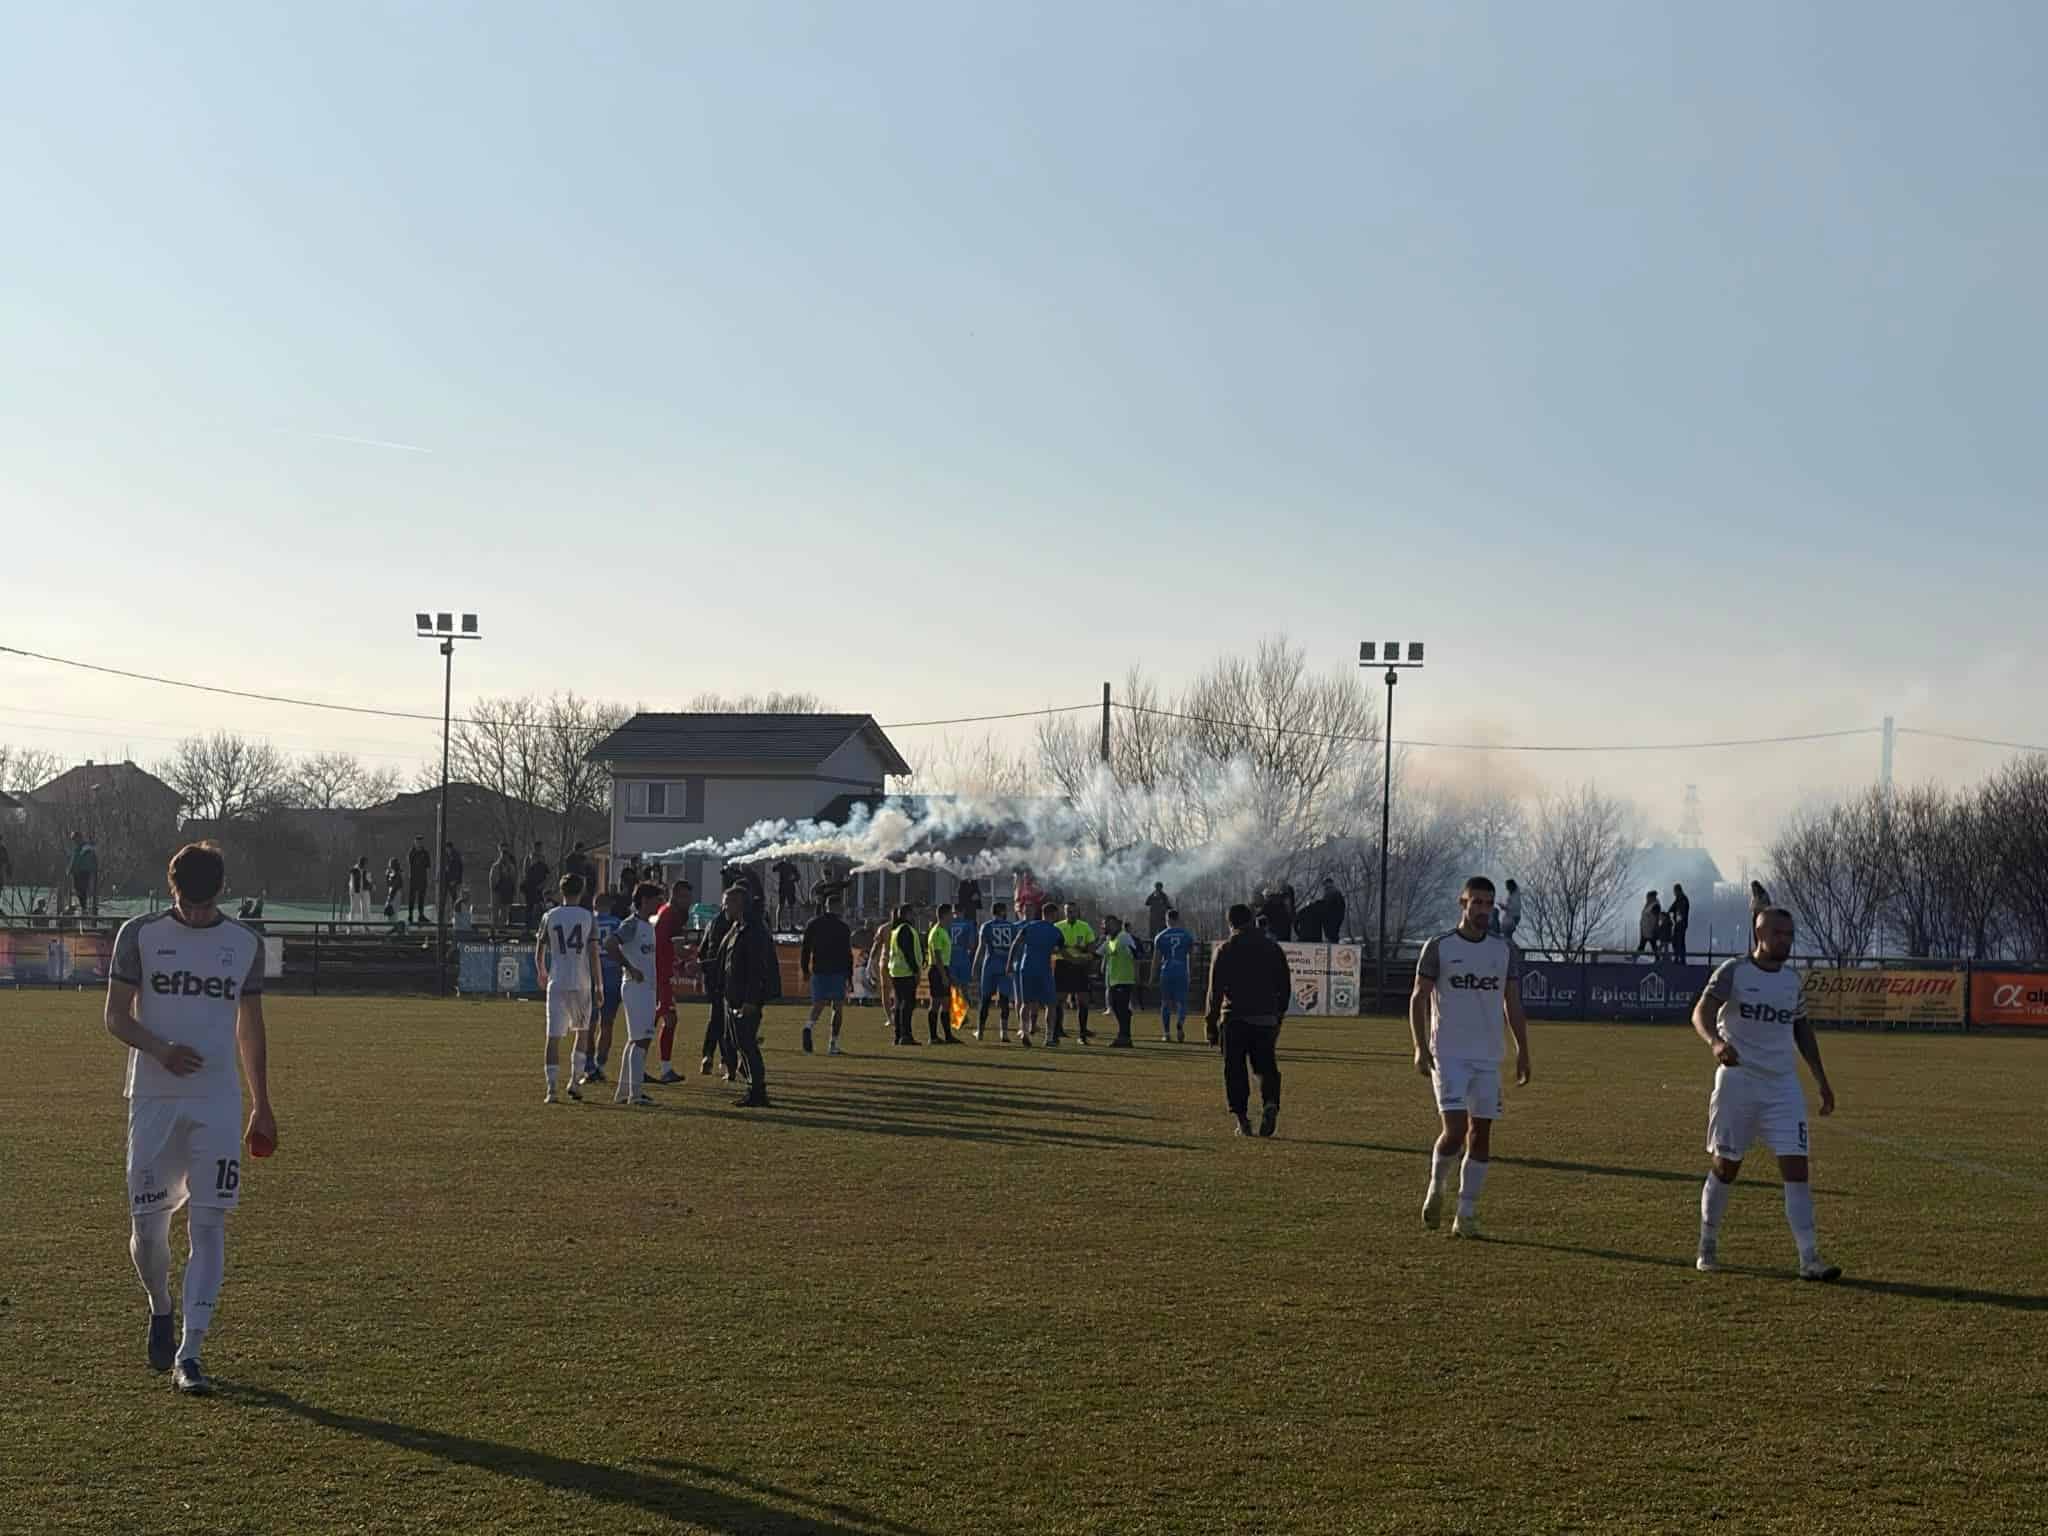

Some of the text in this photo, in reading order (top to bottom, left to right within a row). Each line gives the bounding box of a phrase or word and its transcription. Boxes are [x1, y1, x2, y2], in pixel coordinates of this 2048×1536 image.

[554, 924, 584, 954] 14
[151, 970, 237, 1000] efbet
[1450, 973, 1500, 991] efbet
[1740, 1002, 1794, 1024] efbe
[215, 1158, 240, 1190] 16
